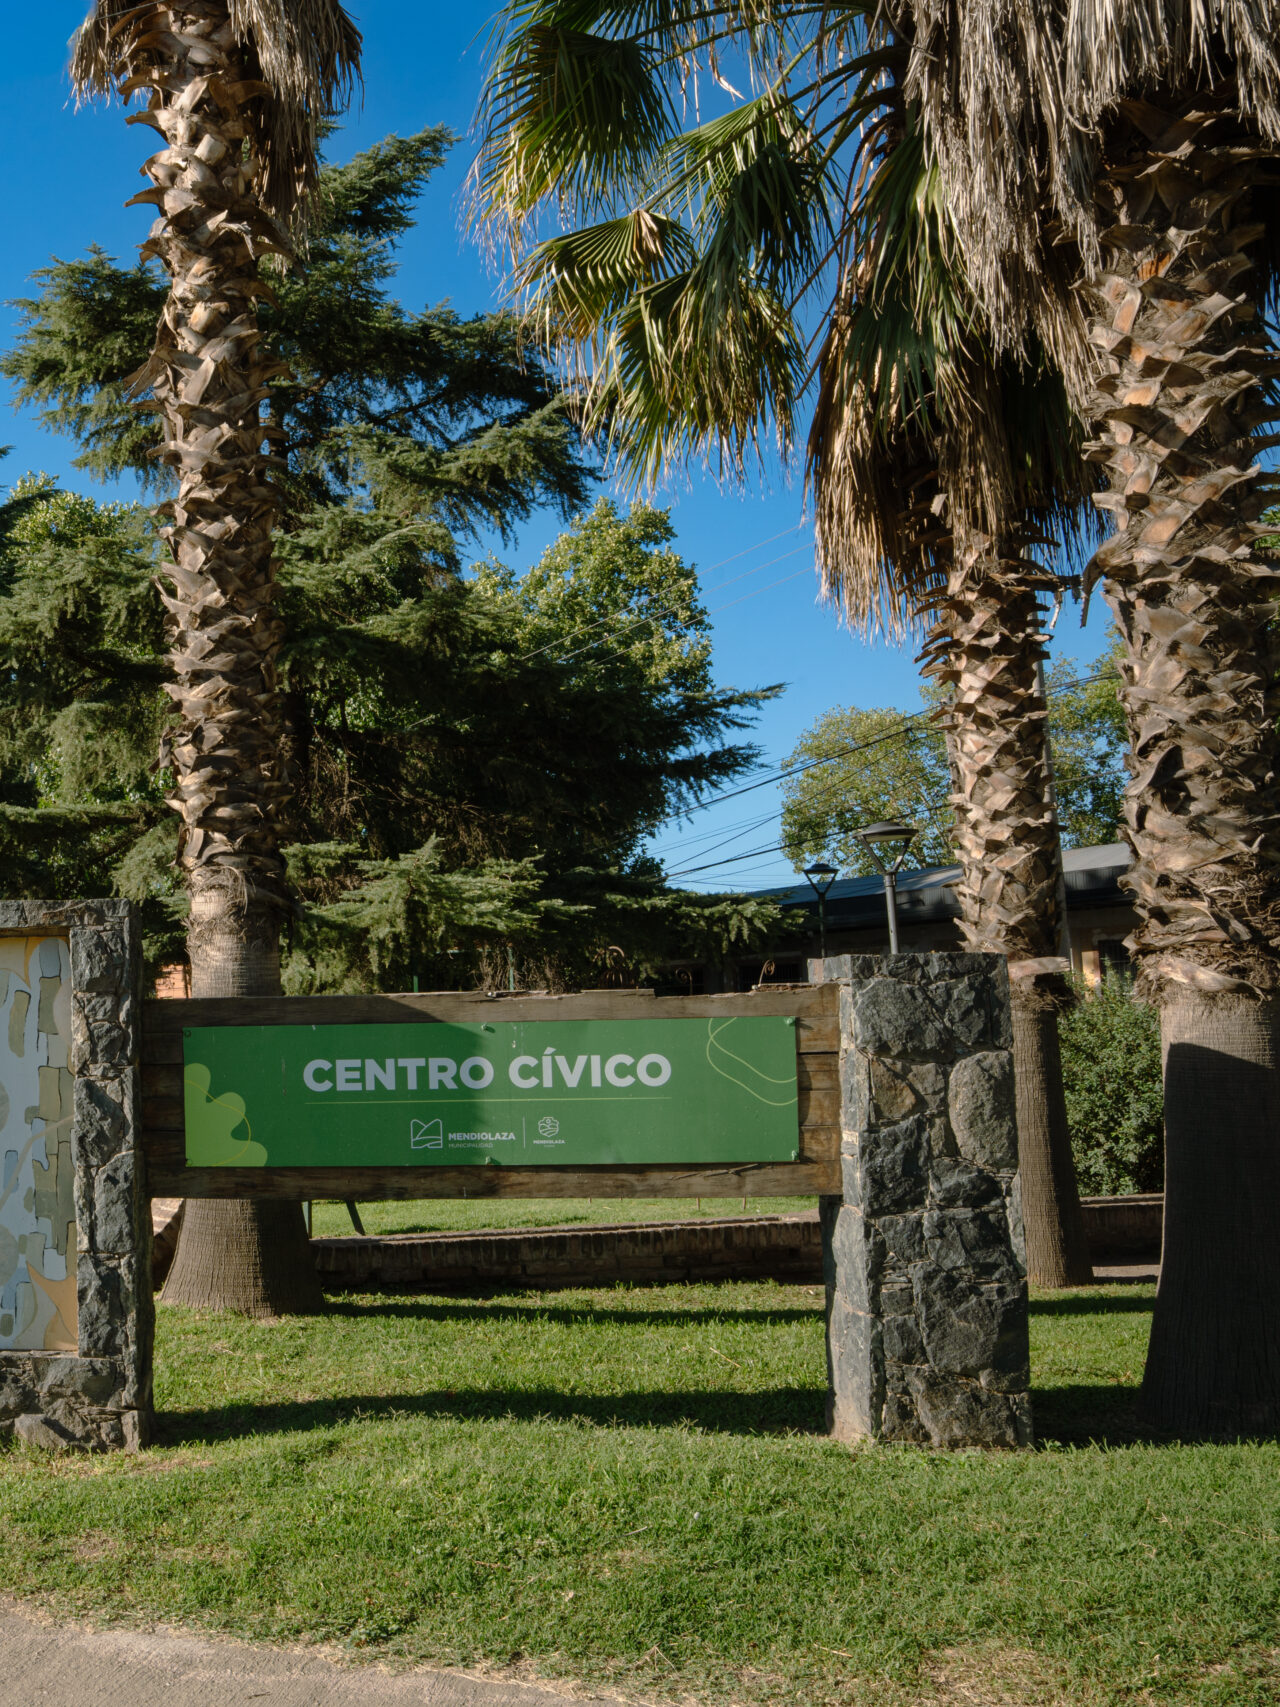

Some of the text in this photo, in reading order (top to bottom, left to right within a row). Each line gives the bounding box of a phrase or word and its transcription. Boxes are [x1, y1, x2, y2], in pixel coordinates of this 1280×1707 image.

[303, 1046, 672, 1092] CENTRO CÍVICO
[448, 1132, 516, 1141] MENDIOLAZA
